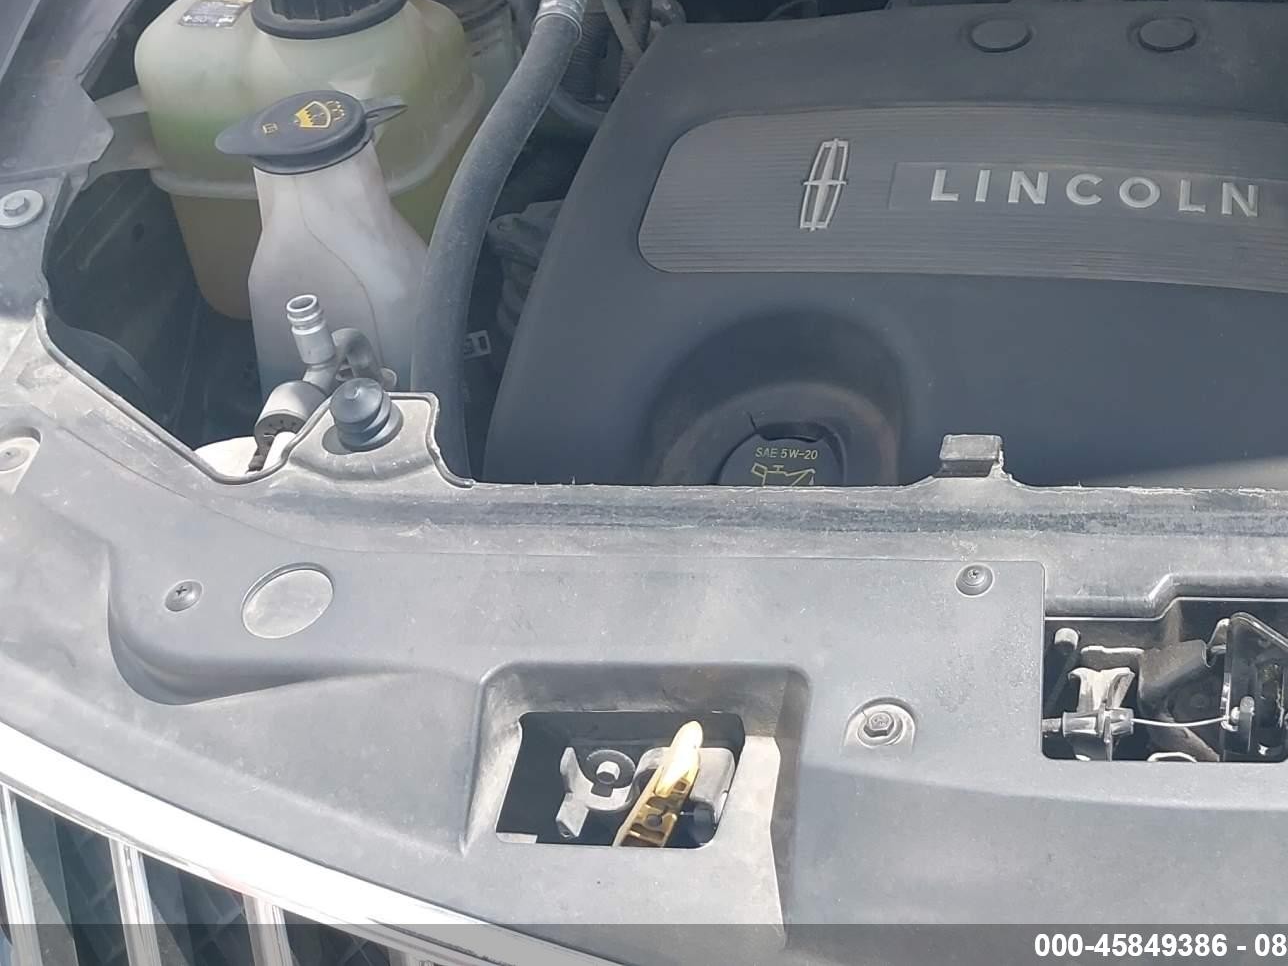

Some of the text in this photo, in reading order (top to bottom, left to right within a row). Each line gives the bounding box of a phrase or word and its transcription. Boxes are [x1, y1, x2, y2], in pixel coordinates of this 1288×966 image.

[930, 169, 1258, 216] LINCOLN
[755, 447, 818, 460] SAE 5W-20
